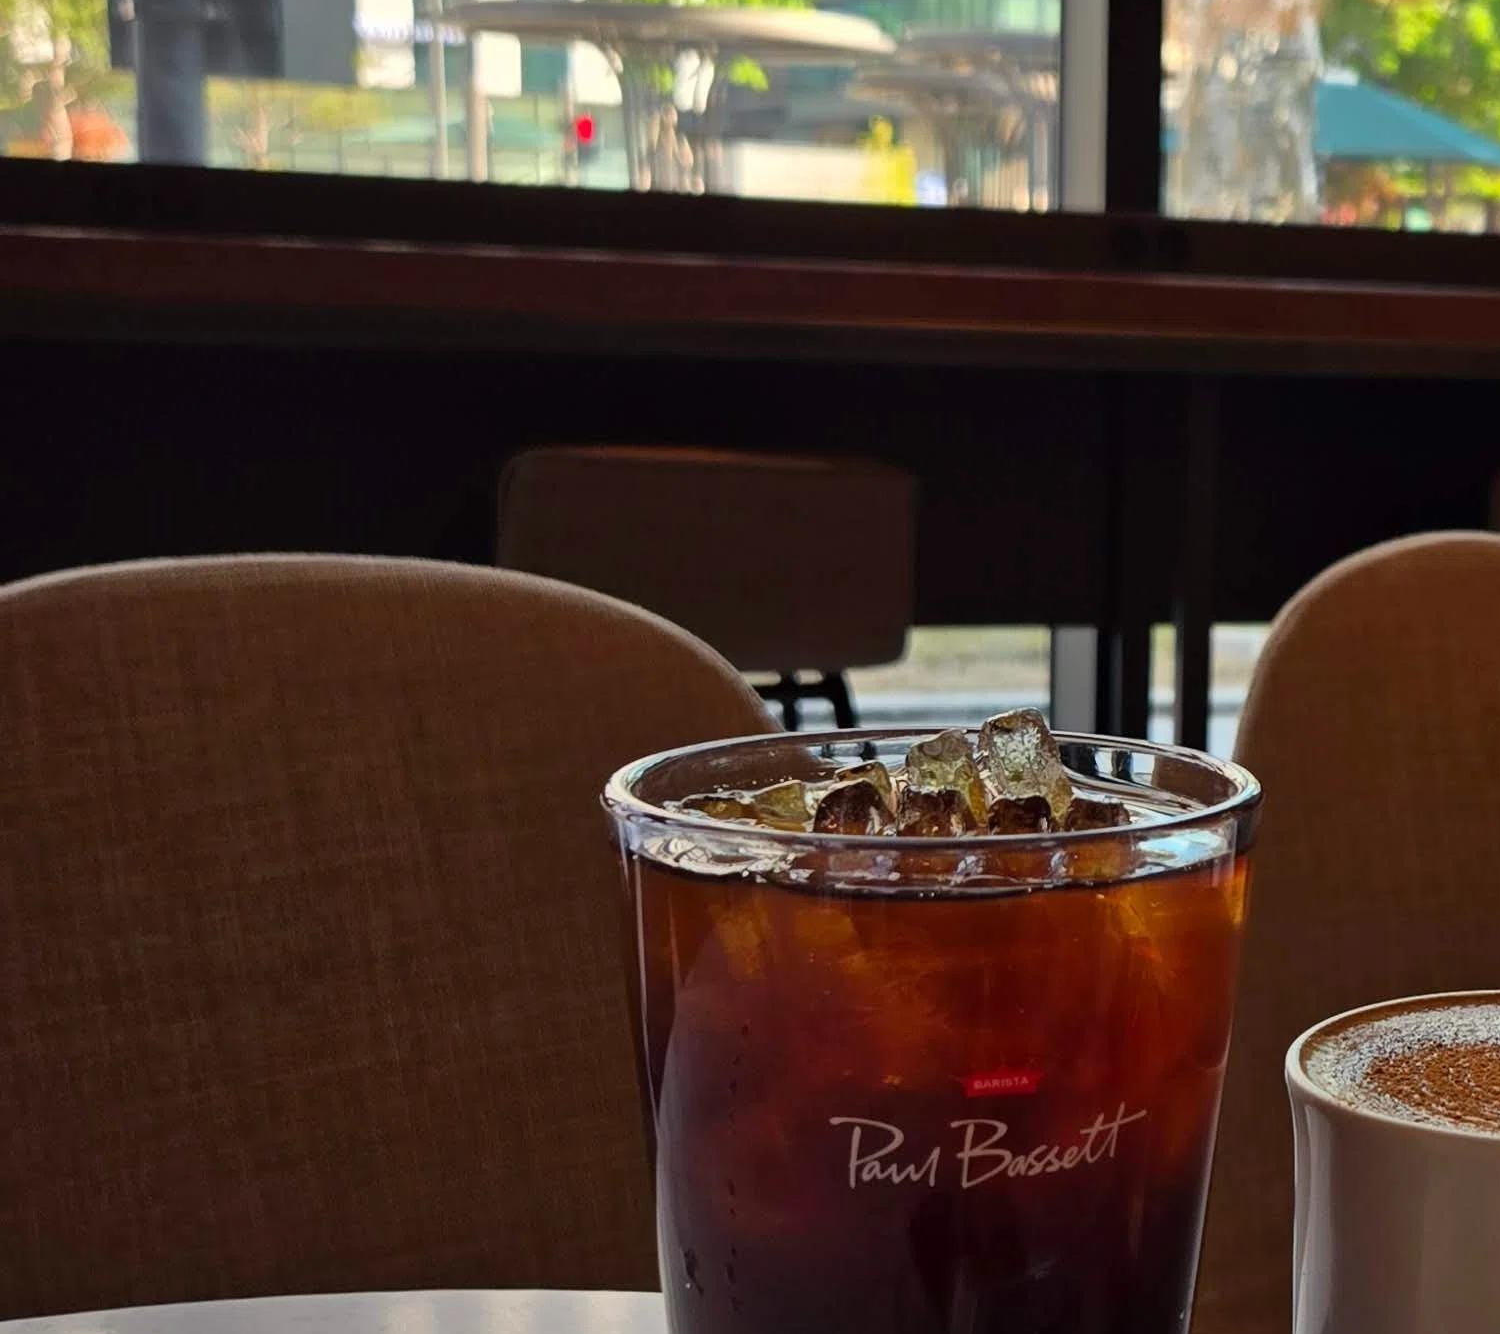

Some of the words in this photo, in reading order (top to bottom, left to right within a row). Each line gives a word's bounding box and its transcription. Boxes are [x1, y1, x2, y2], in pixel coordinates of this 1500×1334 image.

[973, 1076, 1029, 1090] BARISTA
[829, 1115, 943, 1190] Paul
[950, 1101, 1147, 1189] Bassett
